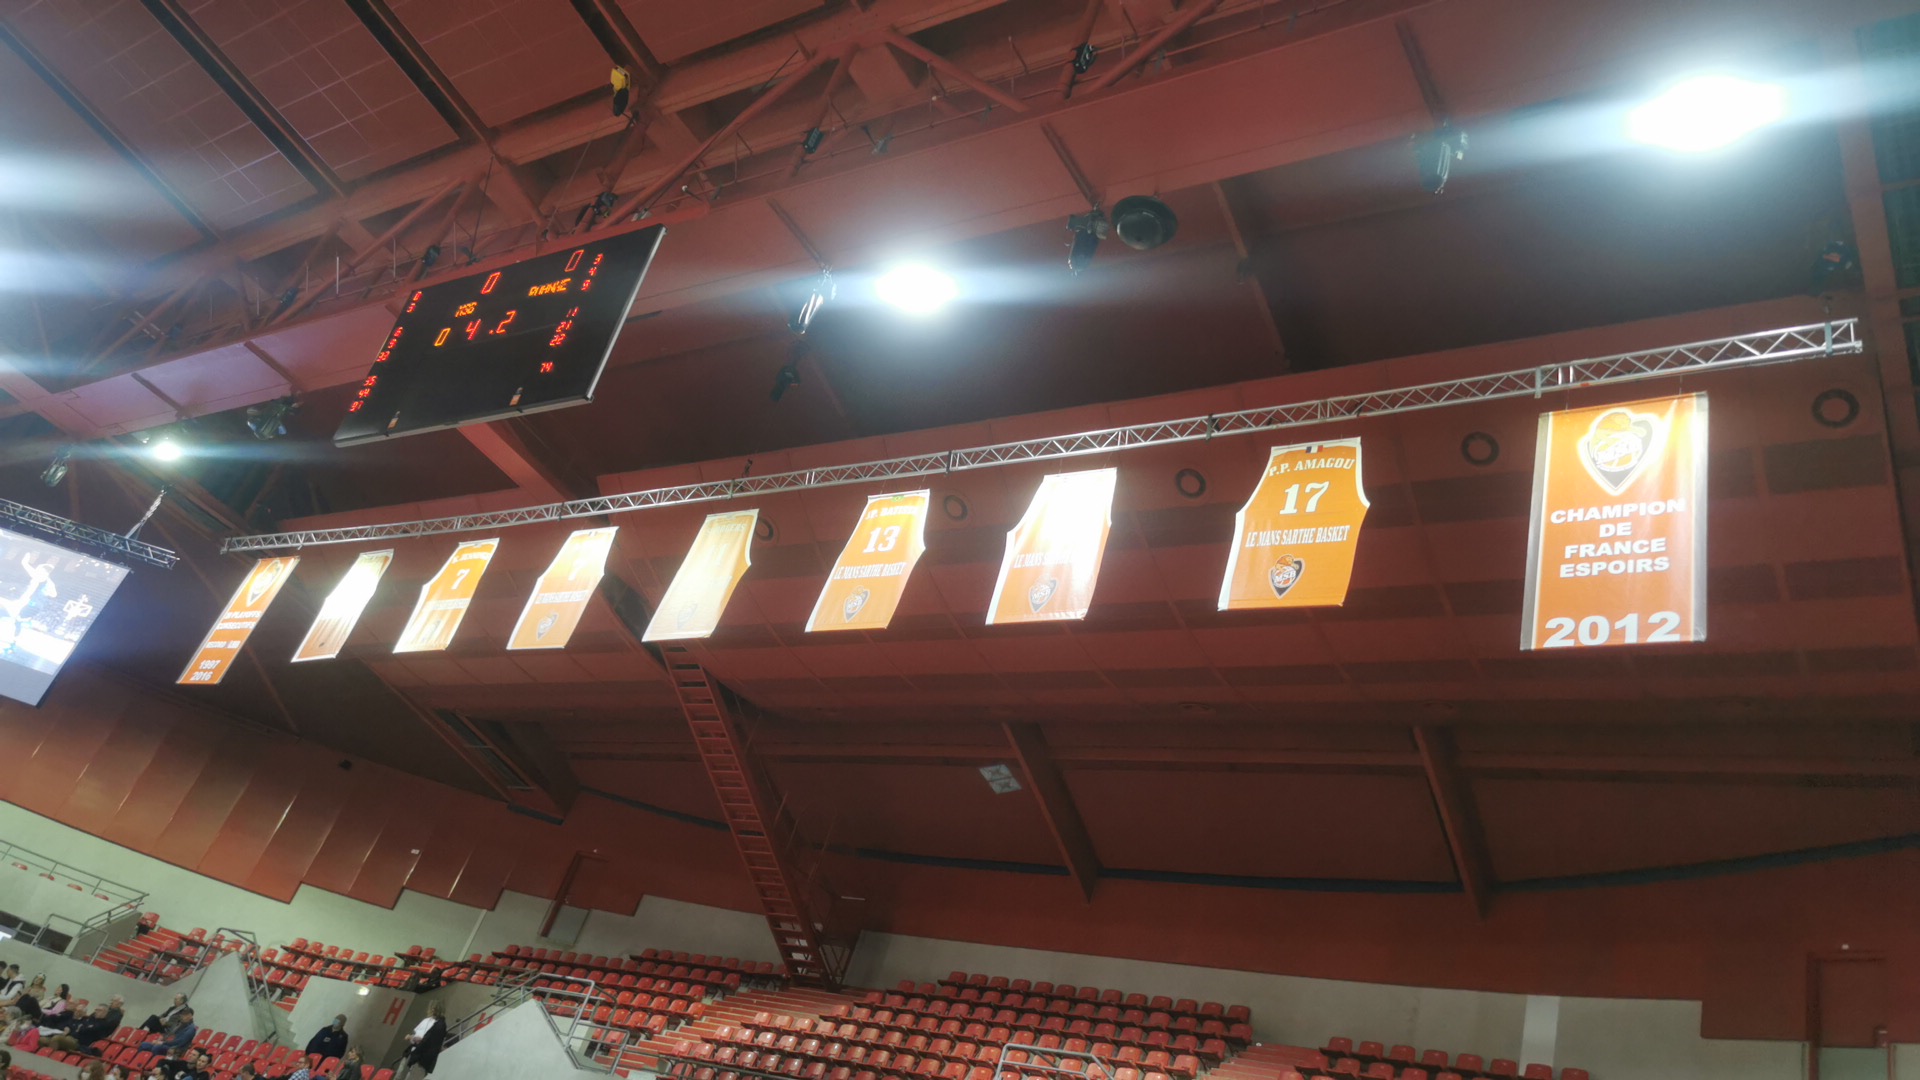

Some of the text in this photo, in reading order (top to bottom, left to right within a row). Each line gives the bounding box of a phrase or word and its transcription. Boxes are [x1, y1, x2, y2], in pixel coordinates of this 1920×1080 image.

[564, 249, 584, 272] 0
[481, 271, 501, 294] 0
[434, 328, 451, 346] 0
[1268, 457, 1355, 477] P.P. AMAGOU
[1279, 481, 1330, 515] 17
[1550, 497, 1686, 524] CHAMPION
[862, 525, 902, 554] 13
[1245, 525, 1350, 548] LE MANS SARTHE BASKET
[1599, 522, 1632, 538] DE
[1564, 538, 1667, 559] FRANCE
[450, 568, 471, 590] 7
[1559, 557, 1670, 578] ESPOIRS
[1542, 611, 1681, 648] 2012
[383, 997, 406, 1026] H
